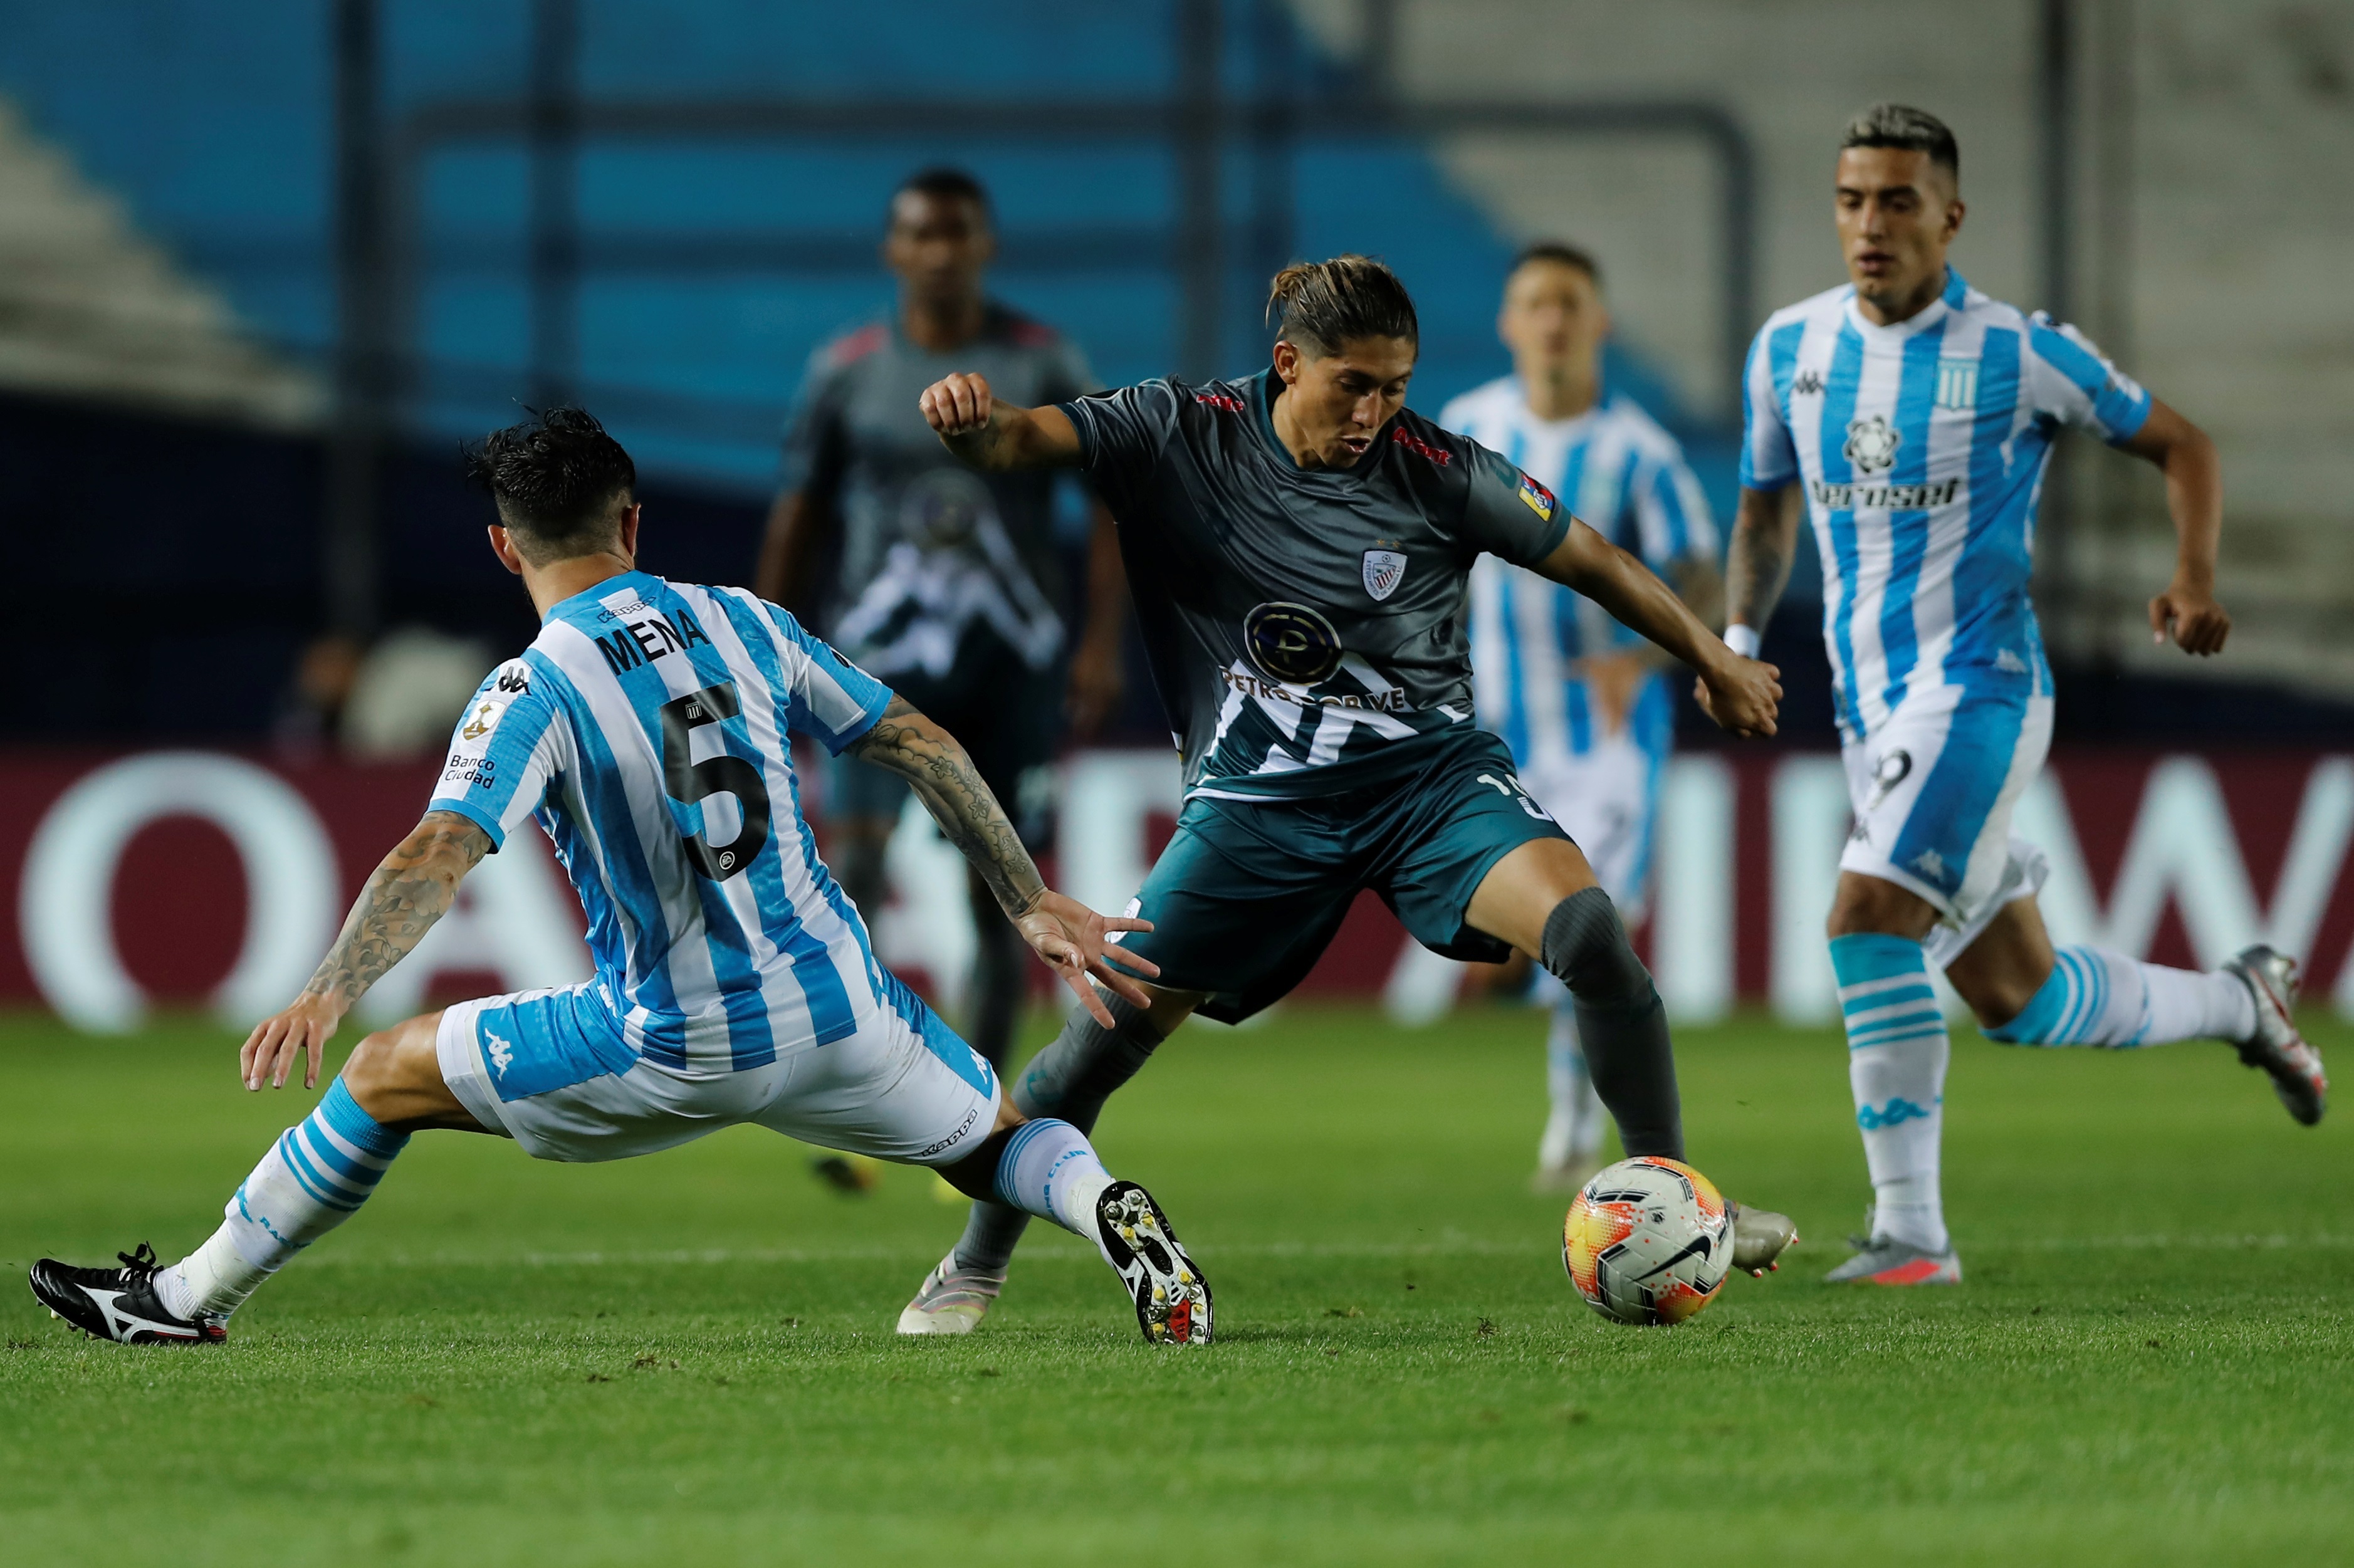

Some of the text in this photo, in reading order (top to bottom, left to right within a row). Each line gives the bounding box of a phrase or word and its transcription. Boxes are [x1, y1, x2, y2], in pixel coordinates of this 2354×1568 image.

[597, 597, 656, 624] Kappa
[595, 609, 710, 676] MENA
[445, 769, 495, 790] Ciudad
[450, 755, 494, 771] Banco
[659, 681, 770, 882] 5
[921, 1109, 978, 1157] Kappa
